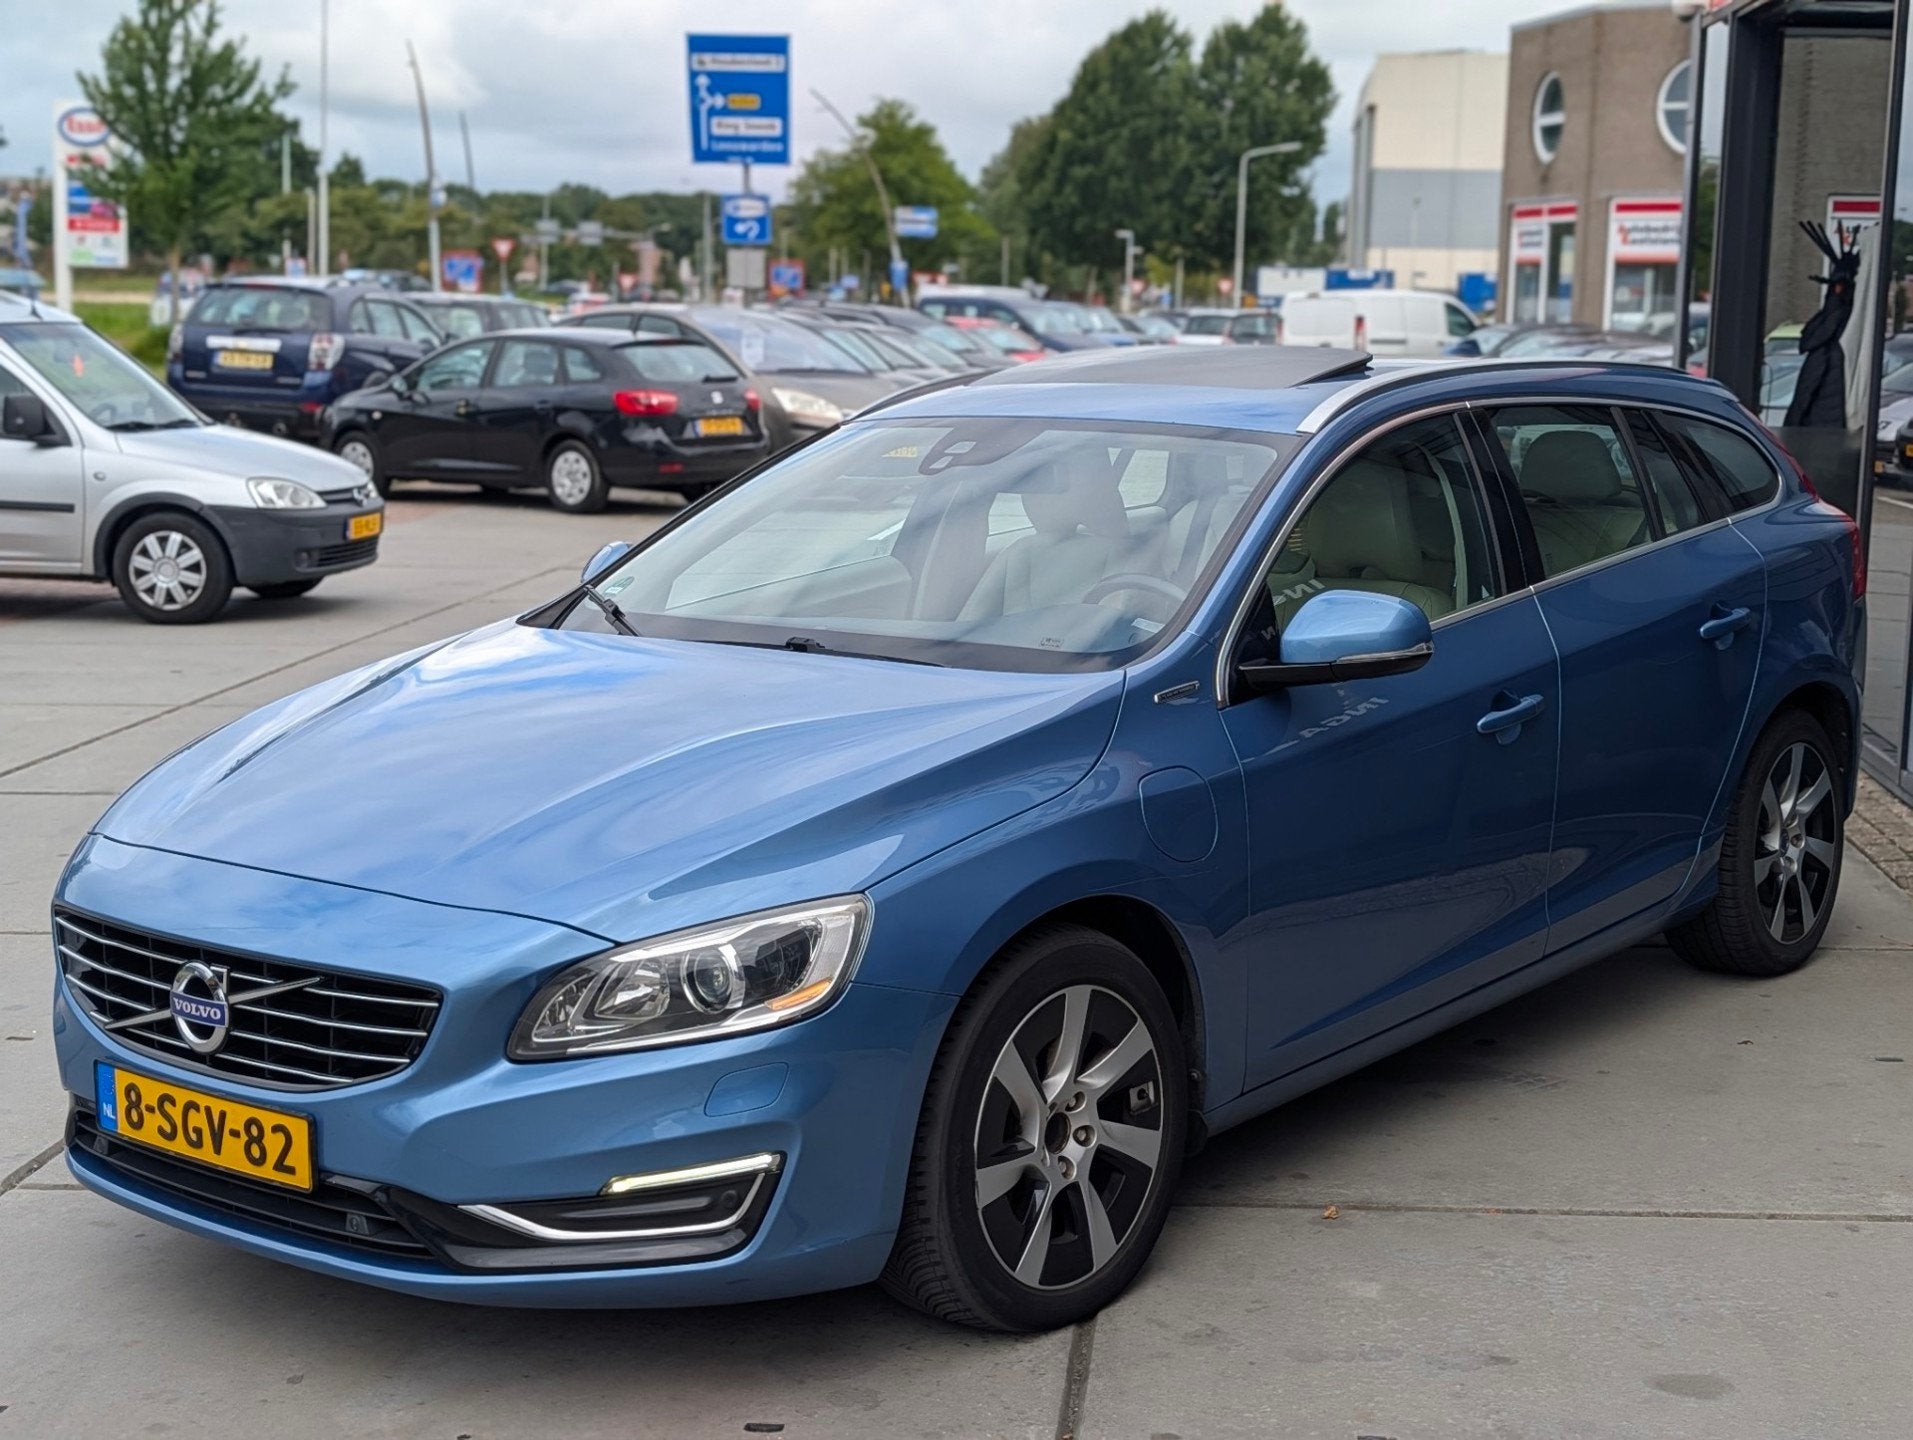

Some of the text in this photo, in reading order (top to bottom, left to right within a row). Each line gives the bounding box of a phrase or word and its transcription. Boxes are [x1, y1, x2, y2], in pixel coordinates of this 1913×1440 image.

[172, 997, 221, 1020] VOLVO
[103, 1102, 116, 1119] NL
[124, 1081, 296, 1176] 8-SGV-82
